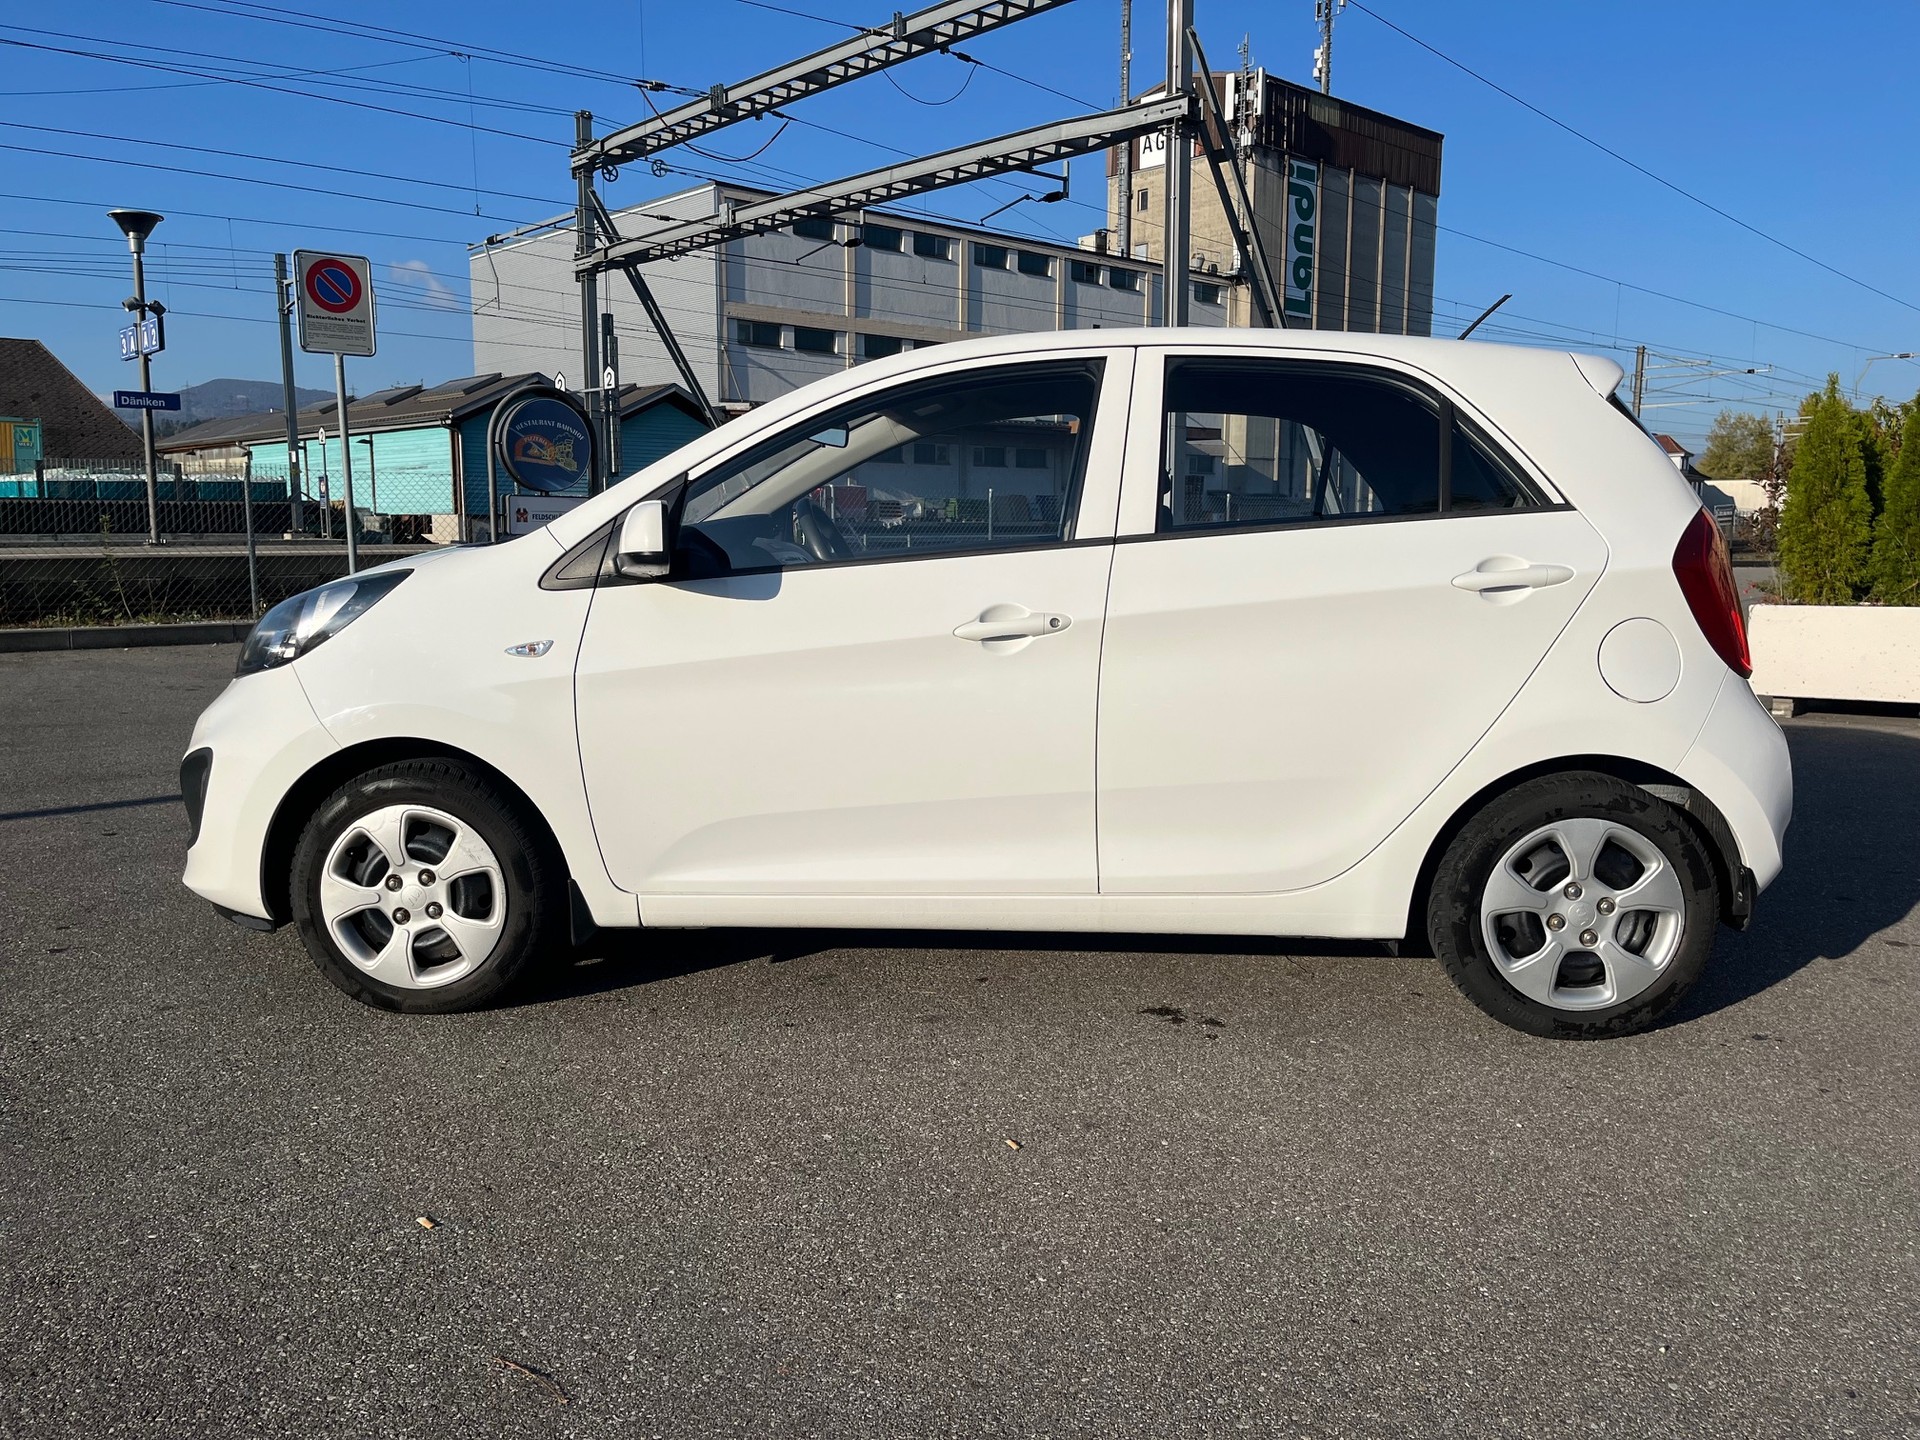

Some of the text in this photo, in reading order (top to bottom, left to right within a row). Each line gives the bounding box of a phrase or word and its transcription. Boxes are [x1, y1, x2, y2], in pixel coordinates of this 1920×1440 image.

[151, 328, 157, 345] 2
[606, 371, 613, 387] 2
[121, 396, 166, 407] Däniken
[515, 419, 556, 431] RESTAURANT
